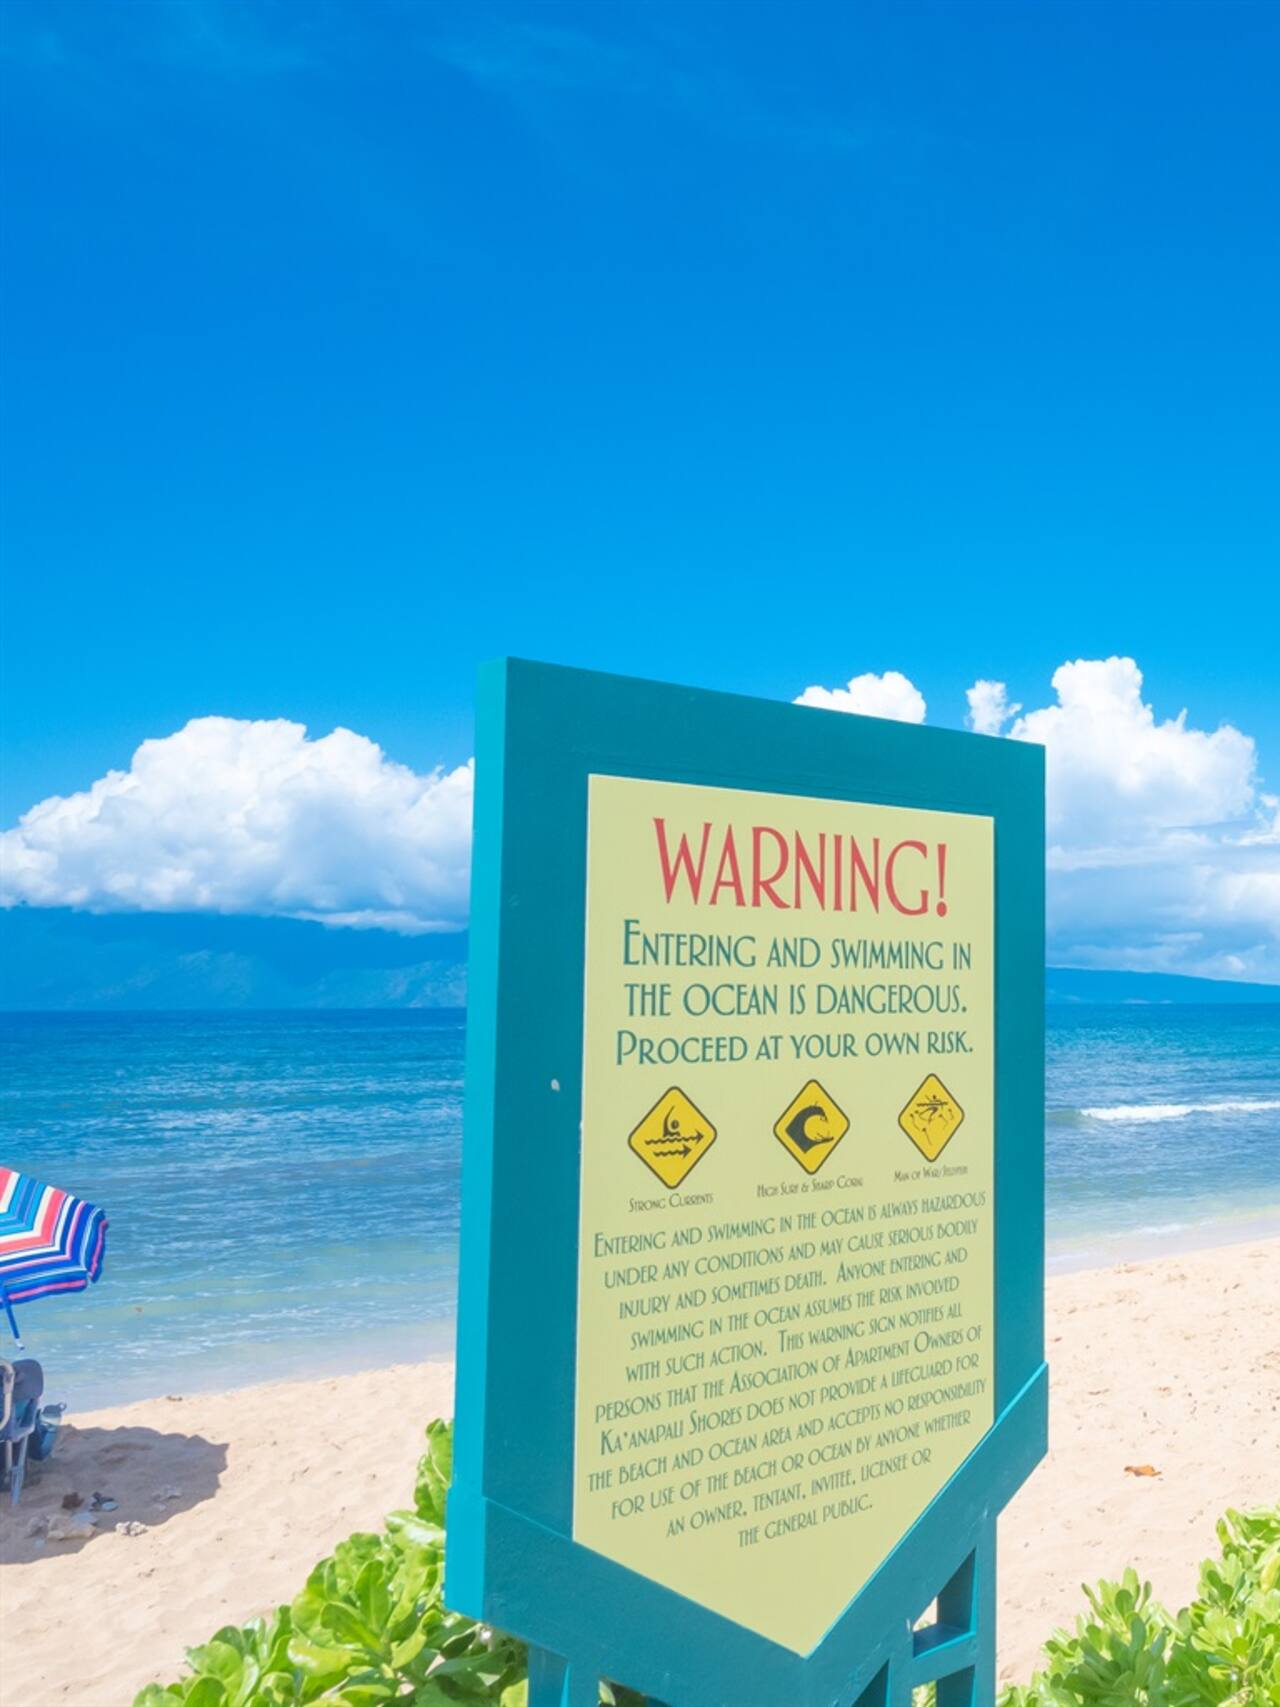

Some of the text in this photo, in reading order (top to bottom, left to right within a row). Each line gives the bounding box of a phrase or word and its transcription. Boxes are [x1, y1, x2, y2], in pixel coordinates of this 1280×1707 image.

[654, 818, 947, 917] WARNING!
[623, 918, 971, 971] ENTERING AND SWIMMING IN
[623, 982, 967, 1017] THE OCEAN IS DANGEROUS.
[616, 1029, 974, 1066] PROCEED AT YOUR OWN RISK.
[594, 1192, 985, 1258] ENTERING AND SWIMMING IN THE OCEAN IS ALWAYS HAZARDOUS
[628, 1197, 666, 1213] STRONG
[604, 1219, 977, 1289] UNDER ANY CONDITIONS AND MAY CAUSE SERIOUS BODILY
[619, 1246, 968, 1320] INJURY AND SOMETIMES DEATH. ANYONE ENTERING AND
[625, 1302, 963, 1383] WITH SUCH ACTION. THIS WARNING SIGN NOTIFIES ALL
[630, 1275, 960, 1351] SWIMMING IN THE OCEAN ASSUMES THE RISK INVOLVED
[595, 1325, 982, 1424] PERSONS THAT THE ASSOCIATION OF APARTMENT OWNERS OF
[689, 1406, 743, 1435] SHORES
[746, 1396, 785, 1422] DOES
[788, 1389, 816, 1411] NOT
[820, 1376, 876, 1404] PROVIDE
[879, 1375, 888, 1390] A
[891, 1359, 953, 1387] LIFEGUARD
[955, 1353, 979, 1372] FOR
[588, 1379, 984, 1492] THE BEACH AND OCEAN AREA AND ACCEPTS NO RESPONSIBILITY
[611, 1409, 971, 1520] FOR USE OF THE BEACH OR OCEAN BY ANYONE WHETHER
[666, 1515, 685, 1537] AN
[860, 1453, 908, 1482] LICENSEE
[911, 1447, 932, 1467] OR
[738, 1493, 873, 1548] THE GENERAL PUBLIC.
